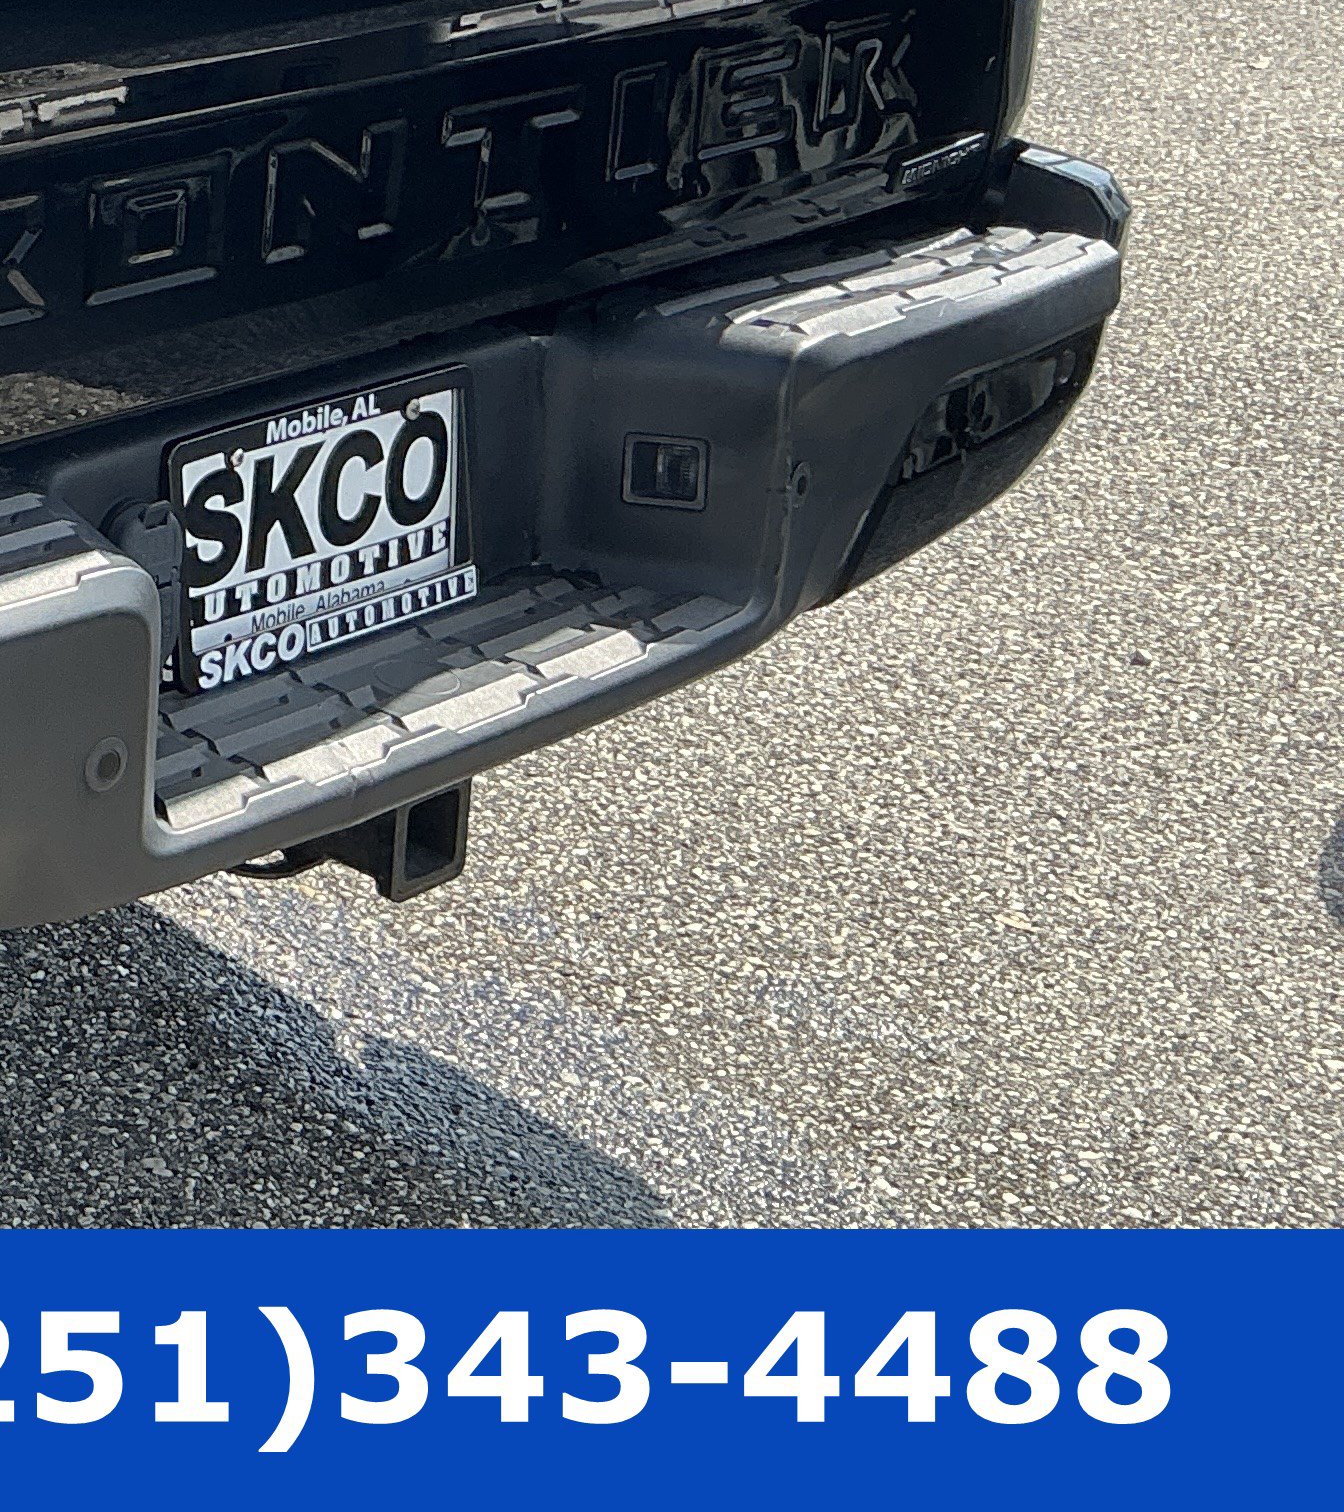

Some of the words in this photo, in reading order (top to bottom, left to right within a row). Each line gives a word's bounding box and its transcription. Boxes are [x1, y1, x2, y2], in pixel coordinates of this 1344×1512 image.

[265, 402, 349, 445] Mobile,
[351, 392, 382, 420] AL
[181, 411, 448, 589] SKCO
[189, 520, 447, 625] UTOMOTIVE
[315, 576, 386, 614] Alabama
[198, 623, 308, 690] SKCO
[309, 569, 477, 646] AUTOMOTIVE
